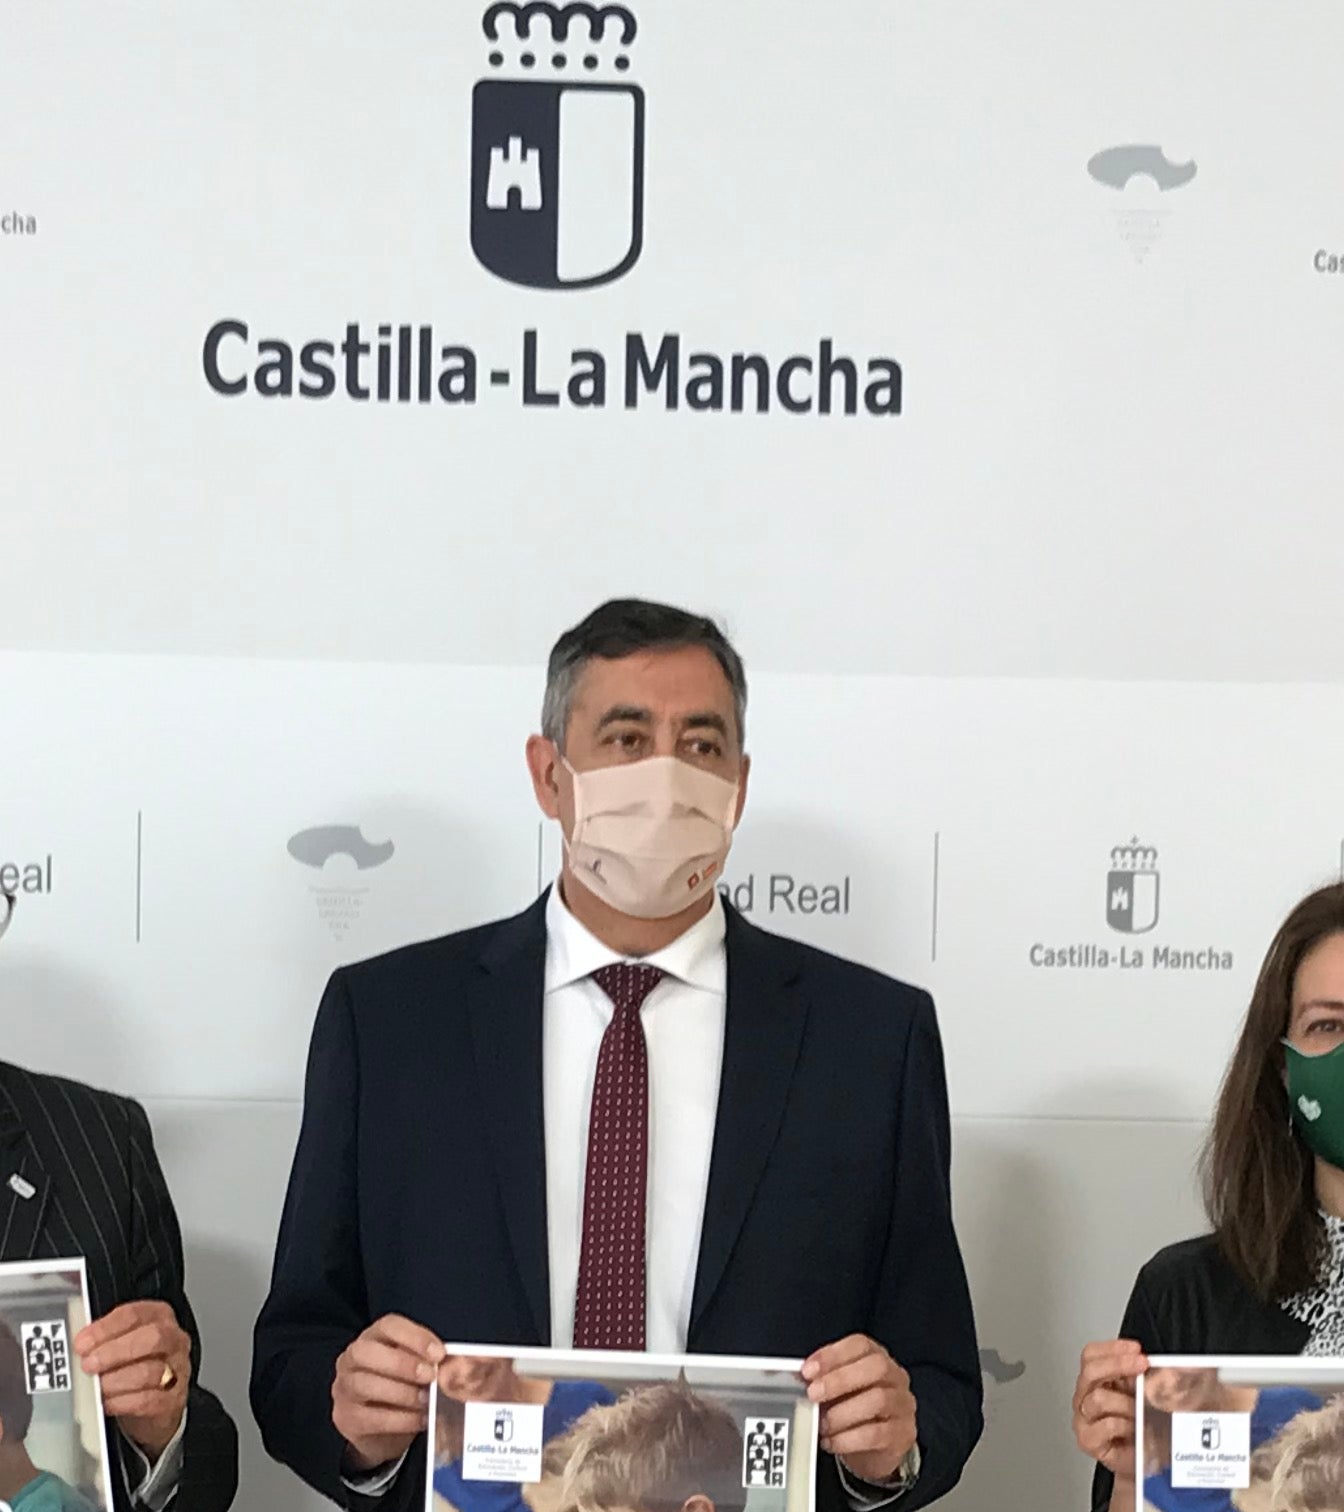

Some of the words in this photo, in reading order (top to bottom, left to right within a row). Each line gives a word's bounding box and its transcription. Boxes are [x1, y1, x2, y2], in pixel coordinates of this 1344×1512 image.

[201, 318, 608, 409] Castilla-La
[625, 330, 904, 418] Mancha
[767, 874, 850, 915] Real
[1028, 942, 1145, 970] Castilla-La
[1152, 944, 1234, 971] Mancha
